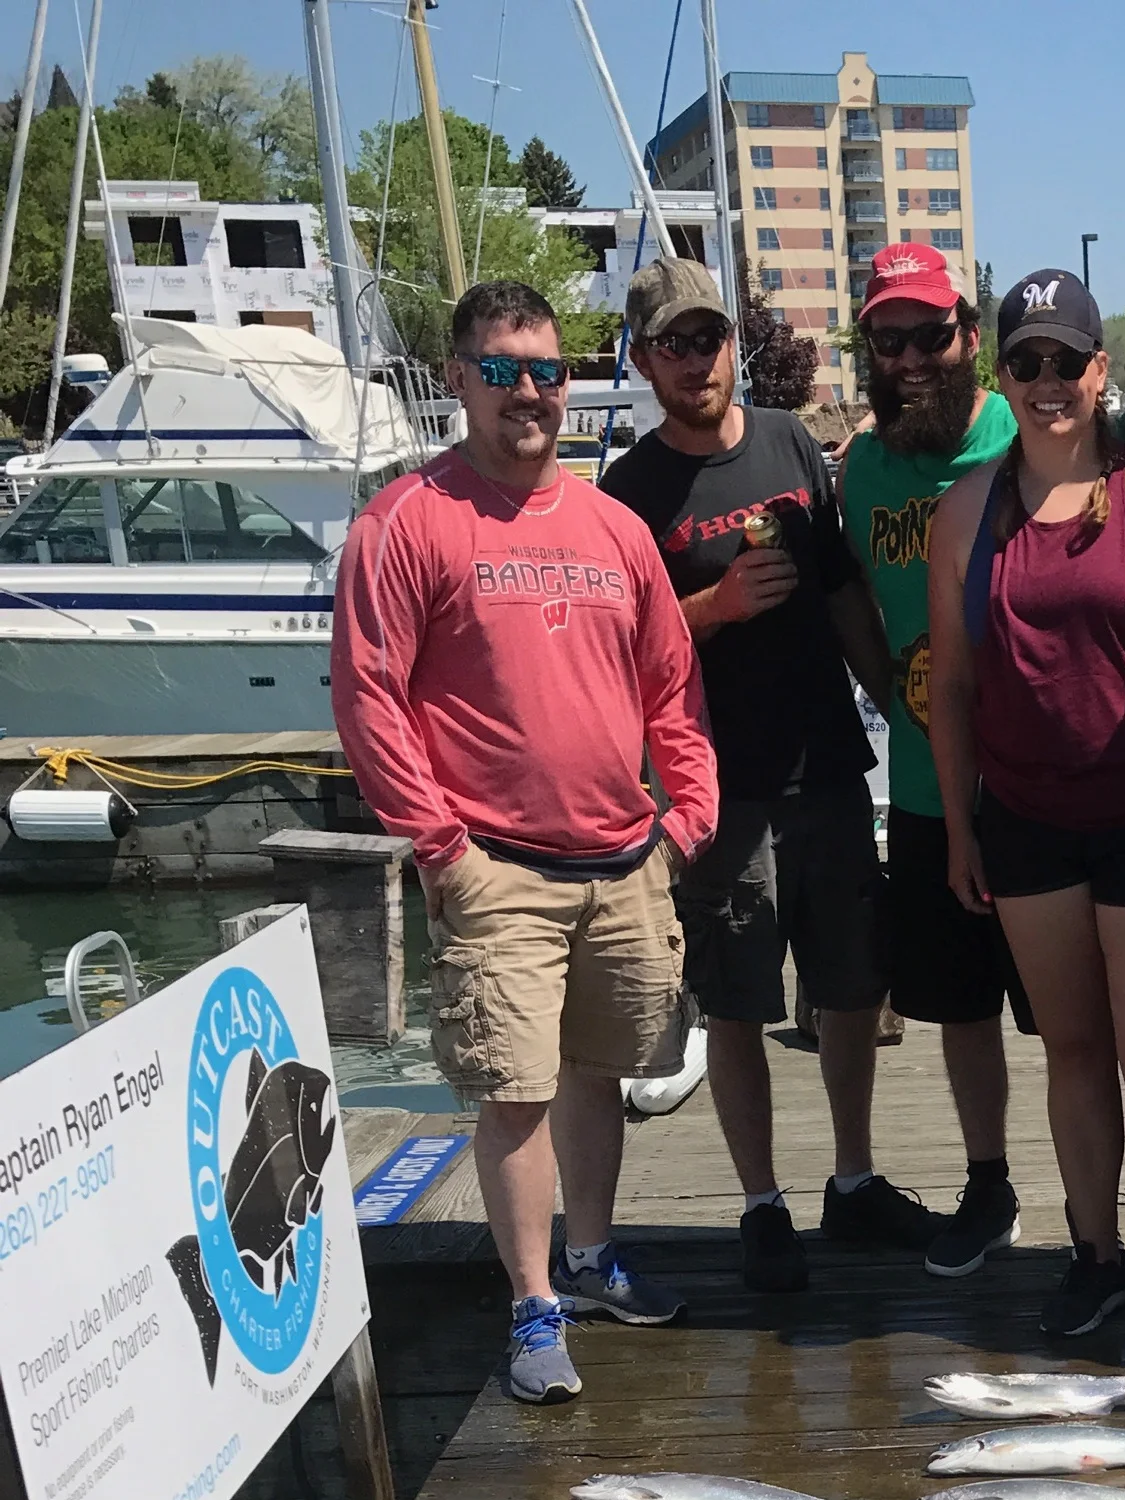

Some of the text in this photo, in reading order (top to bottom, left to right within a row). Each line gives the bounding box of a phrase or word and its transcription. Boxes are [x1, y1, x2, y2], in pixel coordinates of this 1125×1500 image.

[472, 561, 626, 601] BADGERS
[508, 544, 578, 560] WISCONSIN
[541, 599, 571, 633] W
[62, 1092, 114, 1149] Ryan
[113, 1050, 164, 1113] Engel
[193, 986, 283, 1222] OUTCAST
[38, 1145, 116, 1229] 227-9507
[18, 1263, 154, 1397] Premier Lake Michigan
[222, 1231, 317, 1351] CHARTER FISHING
[234, 1362, 259, 1398] PORT
[312, 1238, 332, 1351] WISCONSIN
[30, 1312, 161, 1448] Sport Fishing Charters
